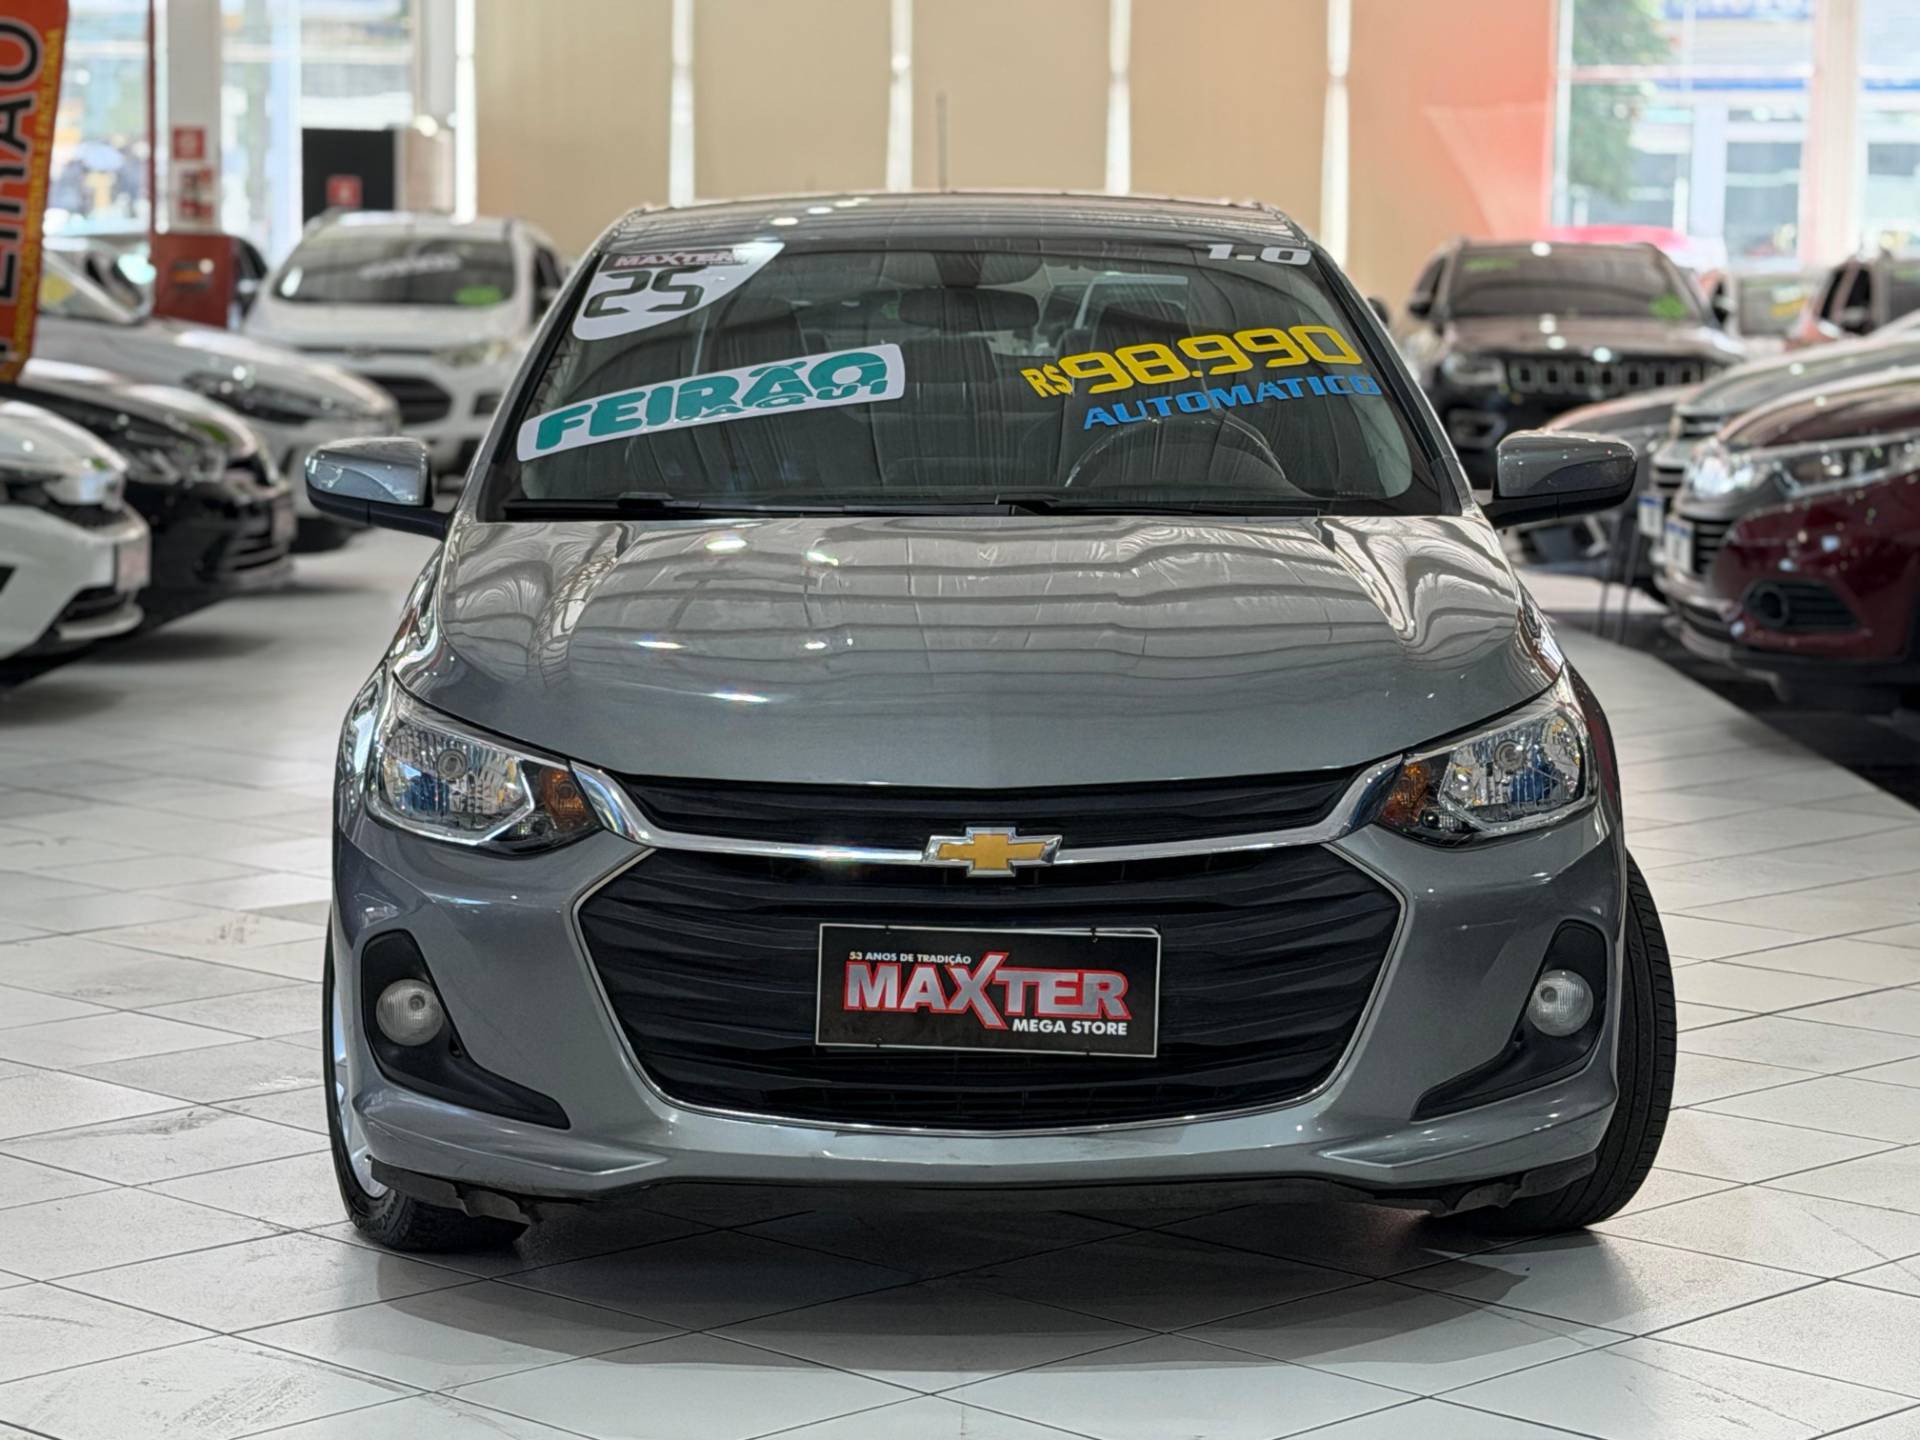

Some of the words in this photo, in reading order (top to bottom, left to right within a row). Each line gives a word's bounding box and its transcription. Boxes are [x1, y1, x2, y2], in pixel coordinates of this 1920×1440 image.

[1206, 243, 1312, 266] 1.0
[583, 265, 705, 318] 25
[535, 351, 889, 451] FEIRÃO
[849, 951, 863, 960] 53
[865, 951, 898, 962] ANOS
[900, 953, 914, 962] DE
[916, 953, 972, 966] TRADIÇÃO
[844, 952, 1131, 1029] MAXTER
[1012, 1018, 1066, 1033] MEGA
[1071, 1021, 1128, 1036] STORE
